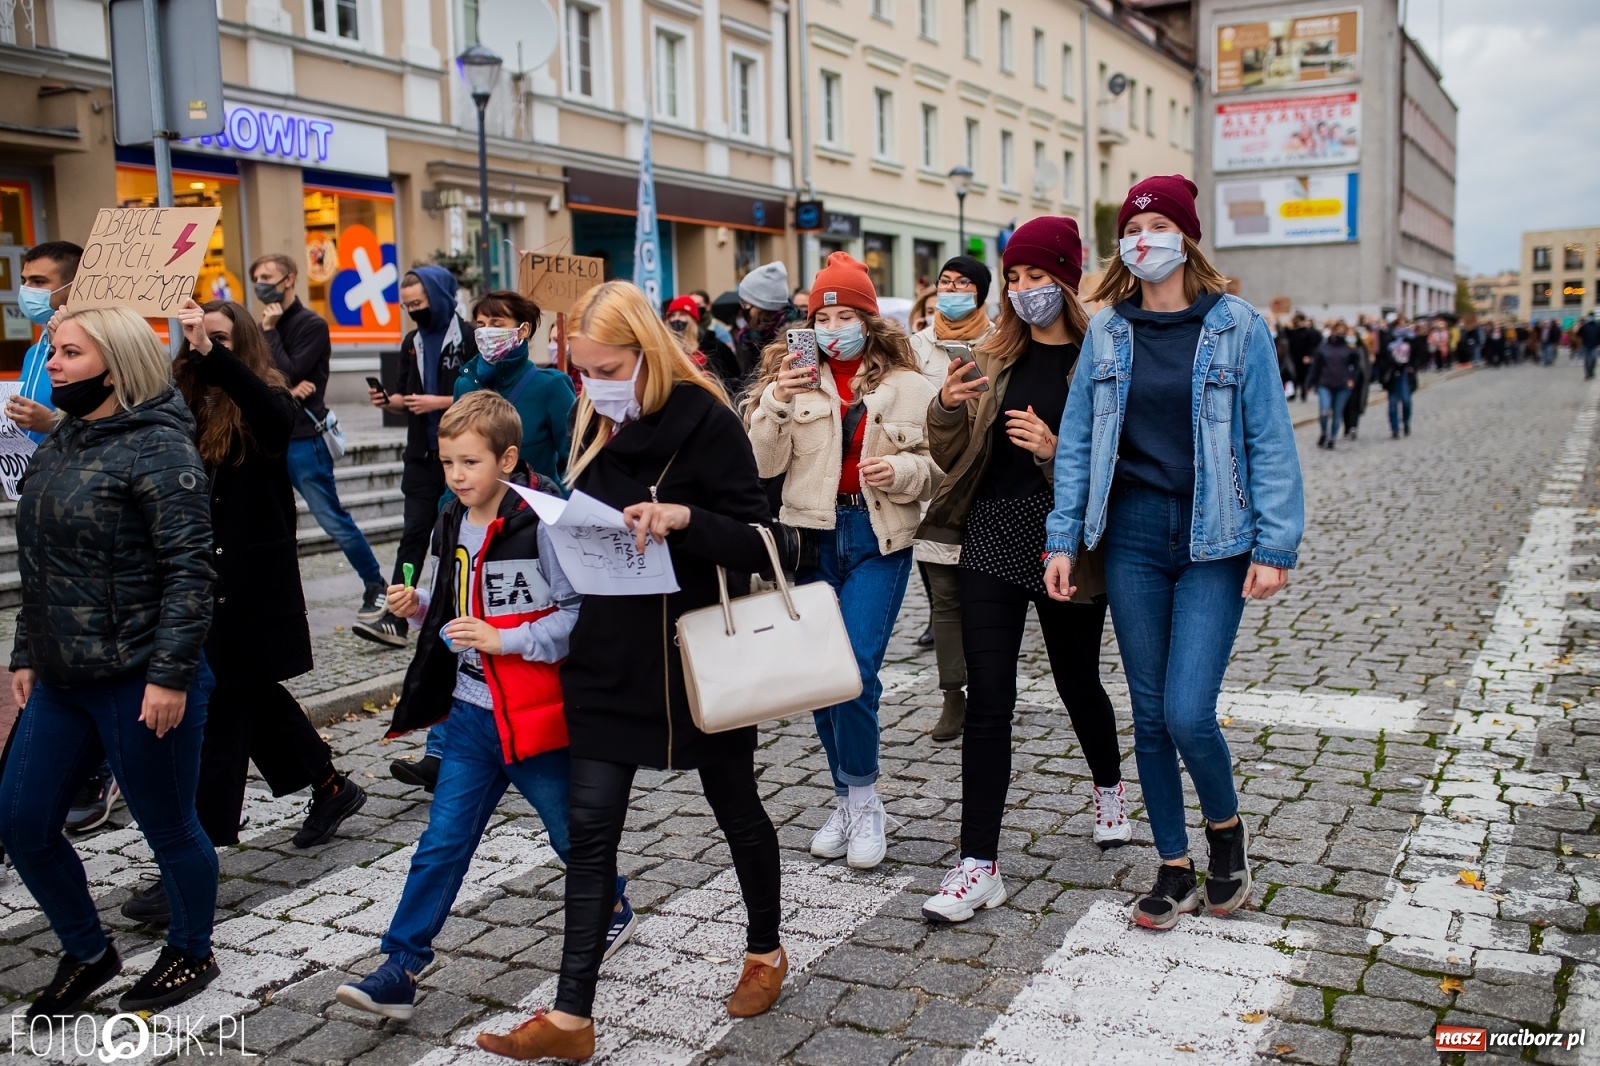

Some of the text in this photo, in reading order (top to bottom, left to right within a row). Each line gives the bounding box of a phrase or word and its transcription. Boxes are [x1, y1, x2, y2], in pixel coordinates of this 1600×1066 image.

[91, 208, 169, 244] DBAJCIE
[531, 254, 598, 279] PIEKŁO
[72, 271, 143, 301] KTÓRZY
[609, 533, 623, 555] NIE
[623, 543, 635, 569] NAS
